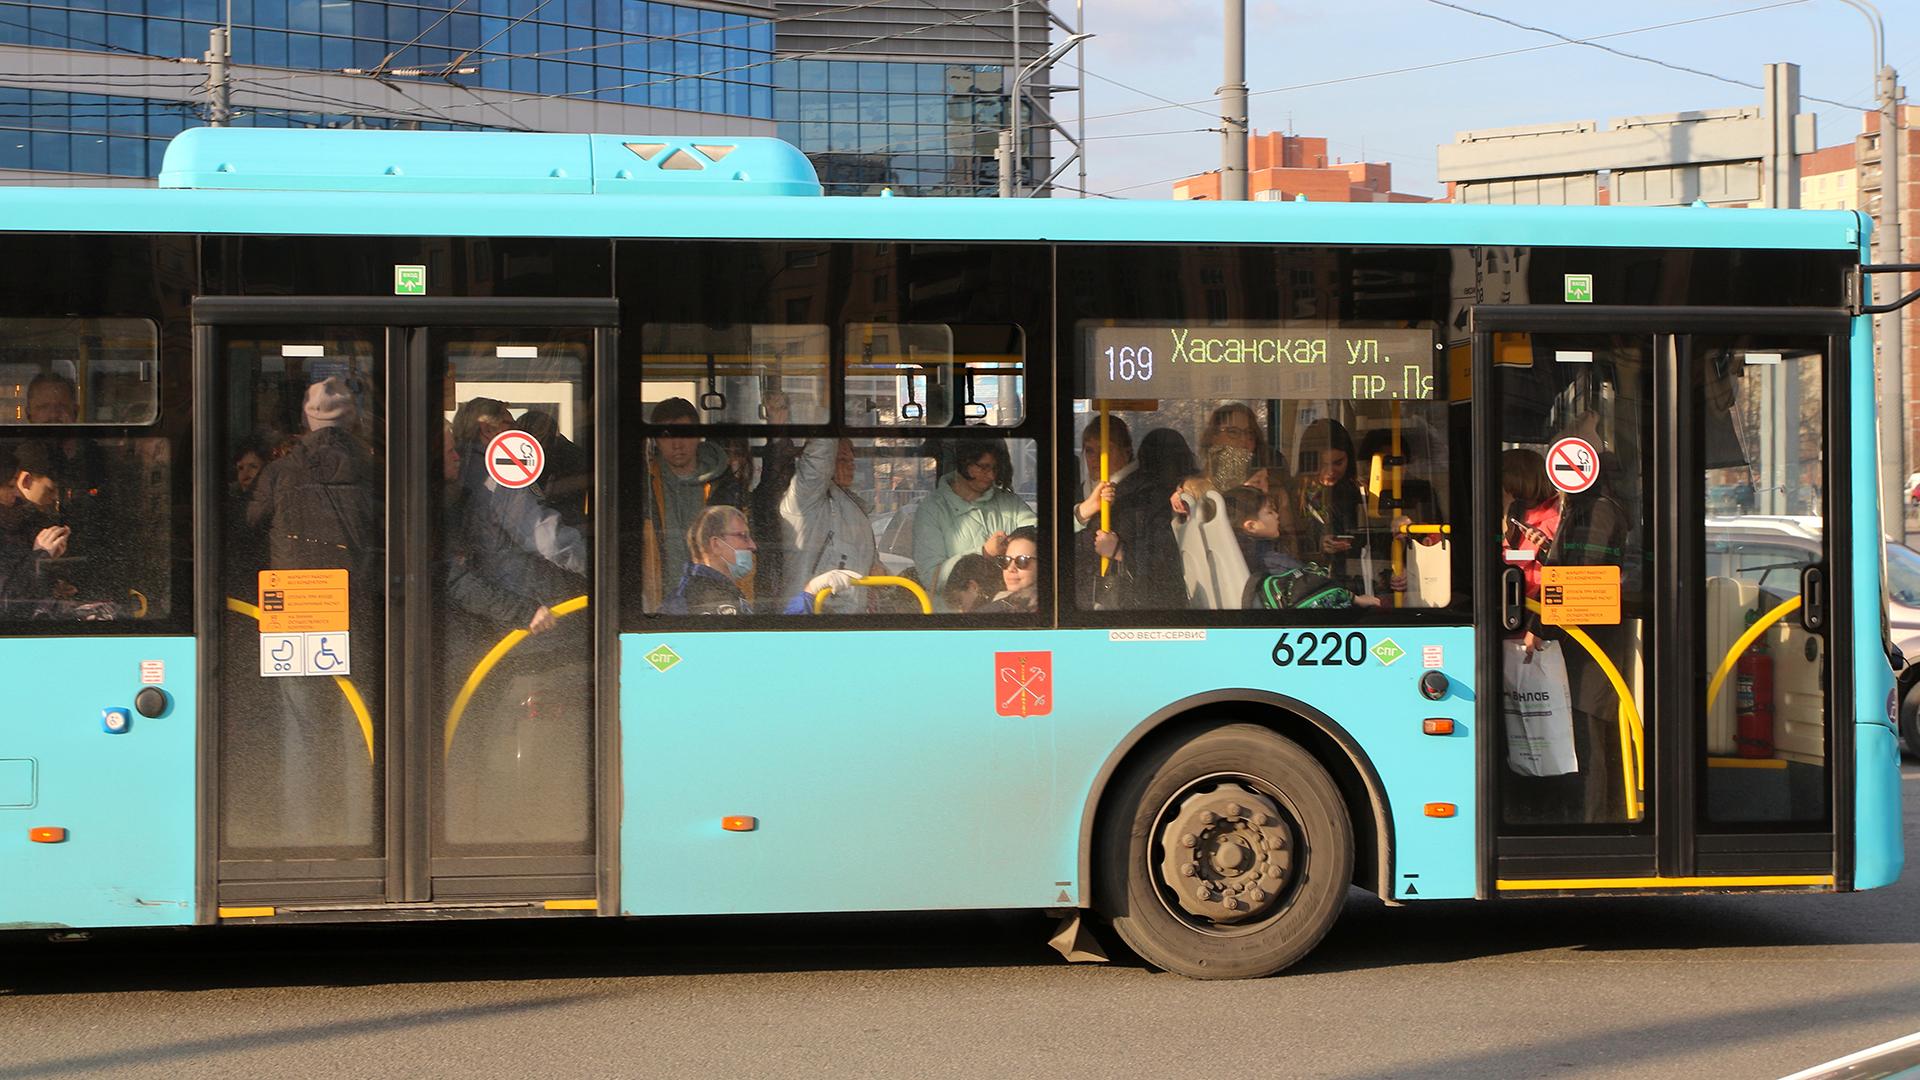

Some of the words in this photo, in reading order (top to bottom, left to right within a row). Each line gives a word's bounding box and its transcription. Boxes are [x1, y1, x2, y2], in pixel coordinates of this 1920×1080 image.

[1171, 329, 1327, 363] Хасанская
[1346, 339, 1391, 365] ул.
[1104, 346, 1153, 381] 169
[1111, 631, 1135, 640] ООО
[1137, 631, 1206, 639] ВЕСТ-СЕРВИС
[651, 653, 673, 663] СПГ
[1272, 632, 1367, 667] 6220
[1376, 645, 1397, 657] СПГ
